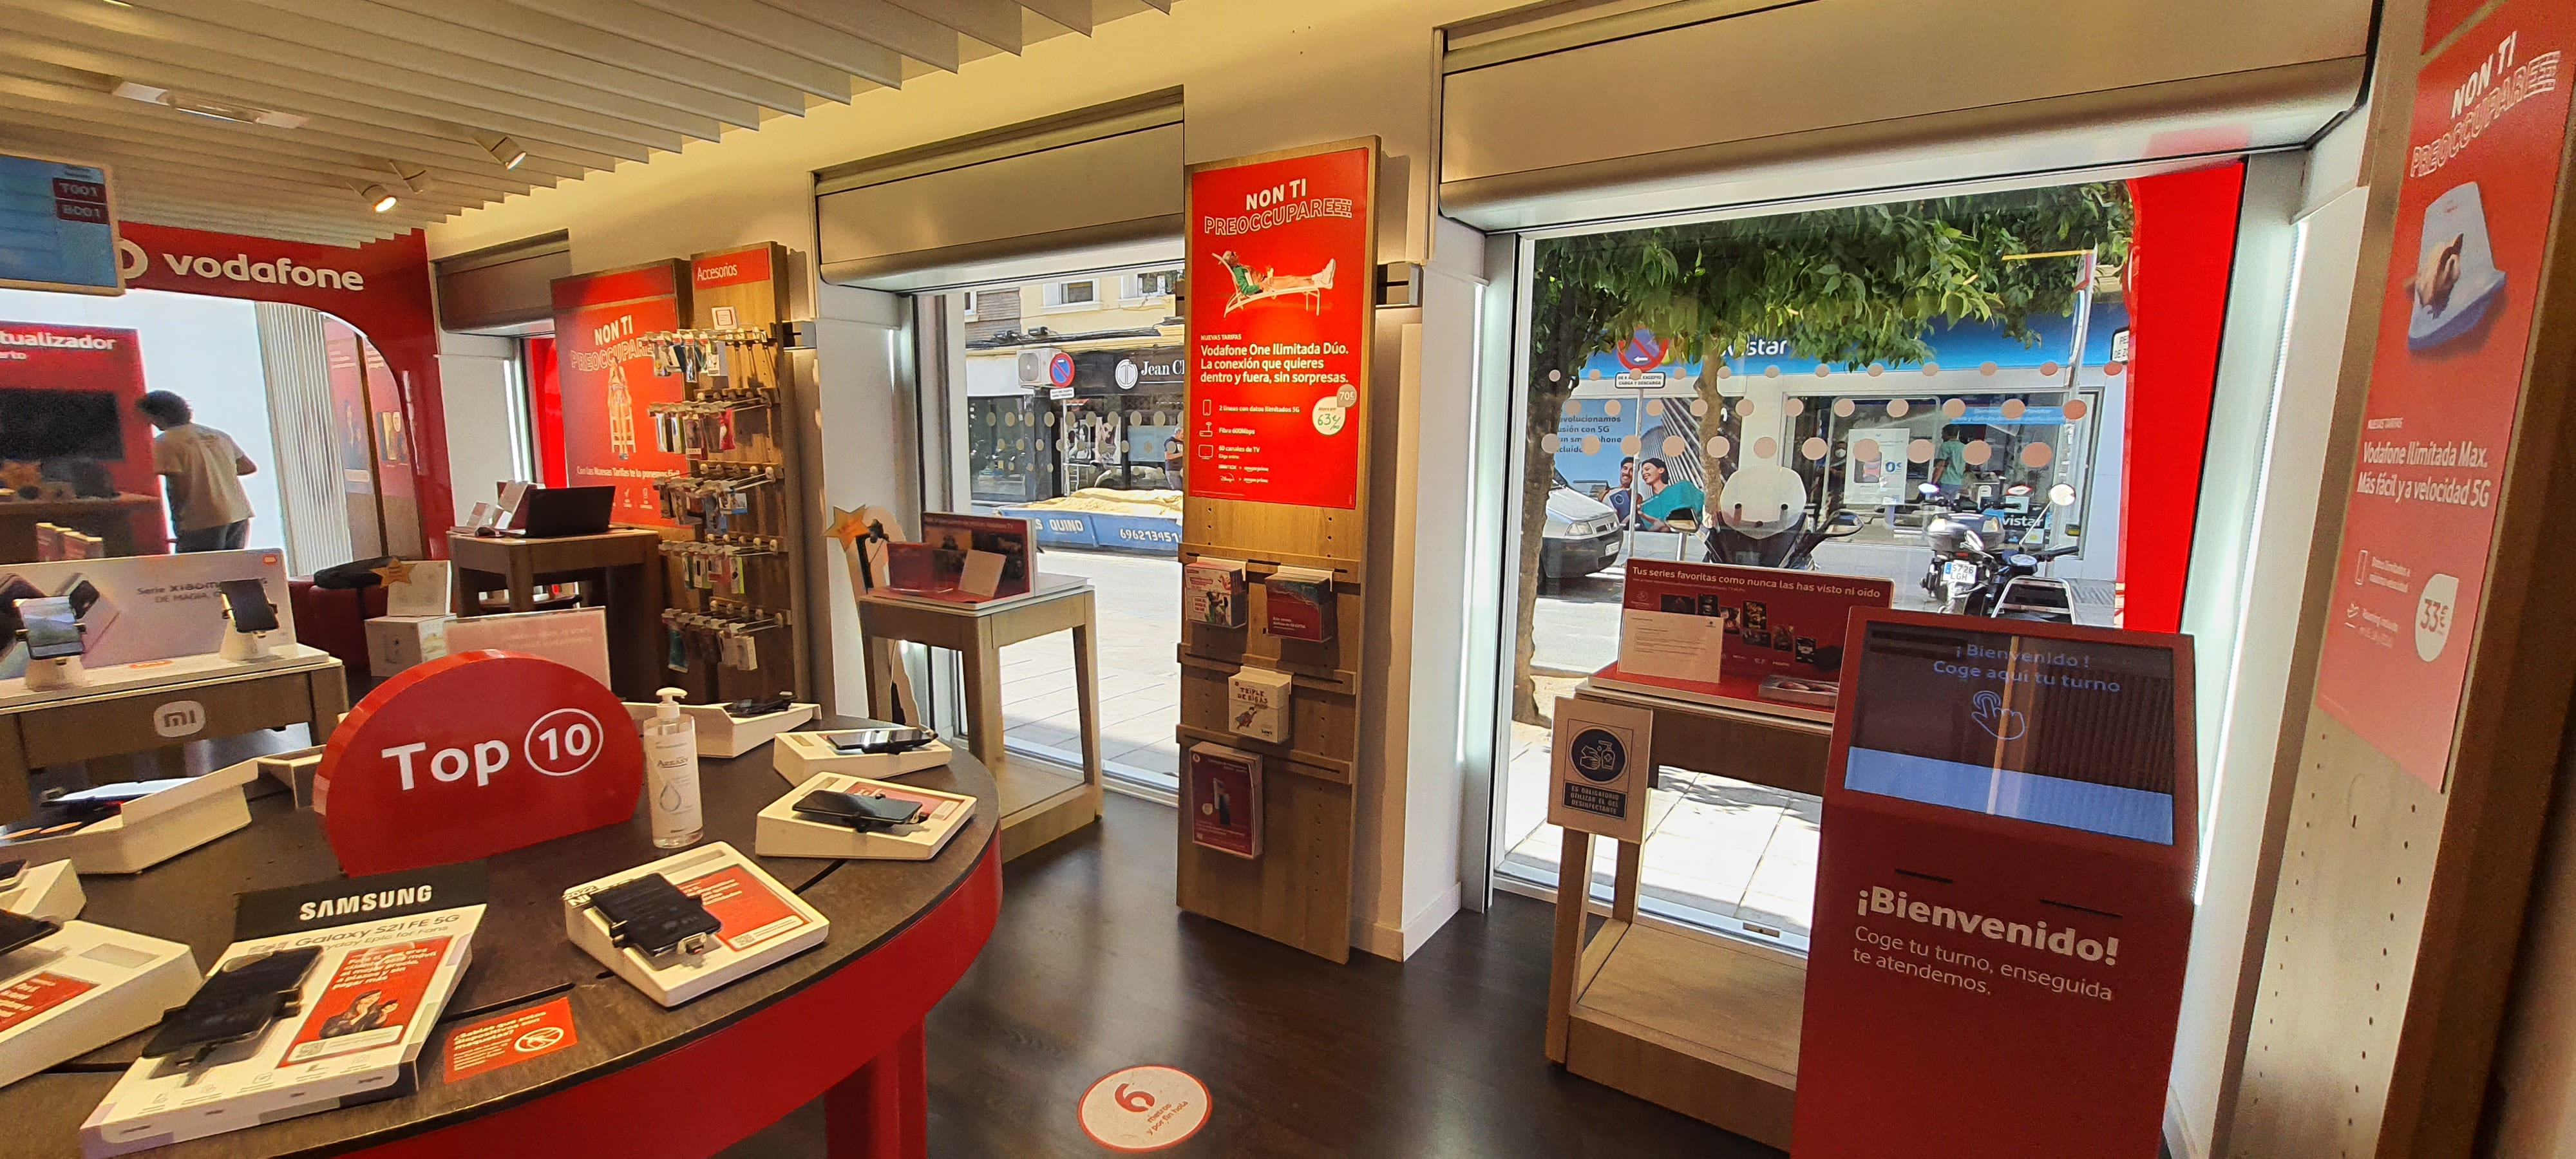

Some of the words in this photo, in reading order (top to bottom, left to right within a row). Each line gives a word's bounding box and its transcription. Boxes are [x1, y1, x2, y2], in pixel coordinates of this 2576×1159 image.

[2451, 53, 2494, 118] NON
[2498, 30, 2518, 76] TI
[1245, 184, 1285, 211] NON
[1289, 178, 1307, 198] TI
[163, 252, 365, 292] vodafone
[697, 262, 738, 281] Accesorios
[594, 319, 620, 346] NON
[620, 314, 634, 335] TI
[1200, 344, 1247, 356] Vodafone
[1249, 343, 1271, 355] One
[1273, 343, 1320, 355] Ilimitada
[1323, 341, 1349, 355] Dúo.
[1141, 361, 1170, 375] Jean
[1200, 359, 1212, 369] La
[1215, 357, 1260, 370] conexión
[1262, 359, 1282, 372] que
[1283, 357, 1324, 372] quieres
[1200, 372, 1233, 382] dentro
[1235, 373, 1241, 385] y
[1243, 371, 1272, 384] fuera,
[1274, 371, 1290, 382] sin
[1292, 373, 1349, 386] sorpresas.
[2363, 442, 2407, 464] Vodafone
[2407, 441, 2457, 466] Ilimitada
[2458, 441, 2488, 468] Max.
[2356, 471, 2376, 494] Más
[2376, 471, 2398, 496] fácil
[2395, 480, 2407, 504] y
[2404, 480, 2412, 498] a
[2413, 476, 2471, 505] velocidad
[2469, 479, 2492, 507] 5G
[2003, 515, 2044, 527] vistar
[1633, 567, 1647, 575] Tus
[1649, 569, 1675, 578] series
[1678, 570, 1716, 582] favoritas
[1719, 576, 1745, 585] como
[1747, 579, 1776, 587] nunca
[1779, 580, 1794, 590] las
[1797, 582, 1814, 592] has
[1817, 584, 1842, 594] visto
[1844, 587, 1854, 596] ni
[1951, 571, 1967, 581] LGH
[1952, 564, 1974, 574] 5726
[2420, 598, 2449, 632] 33€
[1967, 644, 2078, 667] Bienvenido
[1933, 660, 1982, 679] Coge
[2035, 671, 2056, 686] tu
[2061, 674, 2121, 693] turno
[381, 737, 511, 791] Top
[538, 722, 592, 761] 10
[1571, 799, 1618, 815] DESINFECTANTE
[1581, 787, 1620, 800] OBLIGATORIO
[299, 885, 433, 921] SAMSUNG
[295, 928, 373, 947] Galaxy
[374, 922, 405, 934] S21
[408, 918, 430, 928] FE
[433, 914, 460, 925] 5G
[1857, 885, 2119, 966] ¡Bienvenido!
[323, 939, 361, 950] yday
[364, 934, 392, 943] Epic
[1853, 947, 1871, 964] te
[1876, 954, 1991, 995] atendemos.
[1855, 926, 1904, 951] Coge
[1909, 938, 1929, 957] tu
[1935, 945, 1994, 975] turno,
[2000, 964, 2112, 1001] enseguida
[1147, 1103, 1172, 1123] metros
[1171, 1100, 1188, 1113] hola
